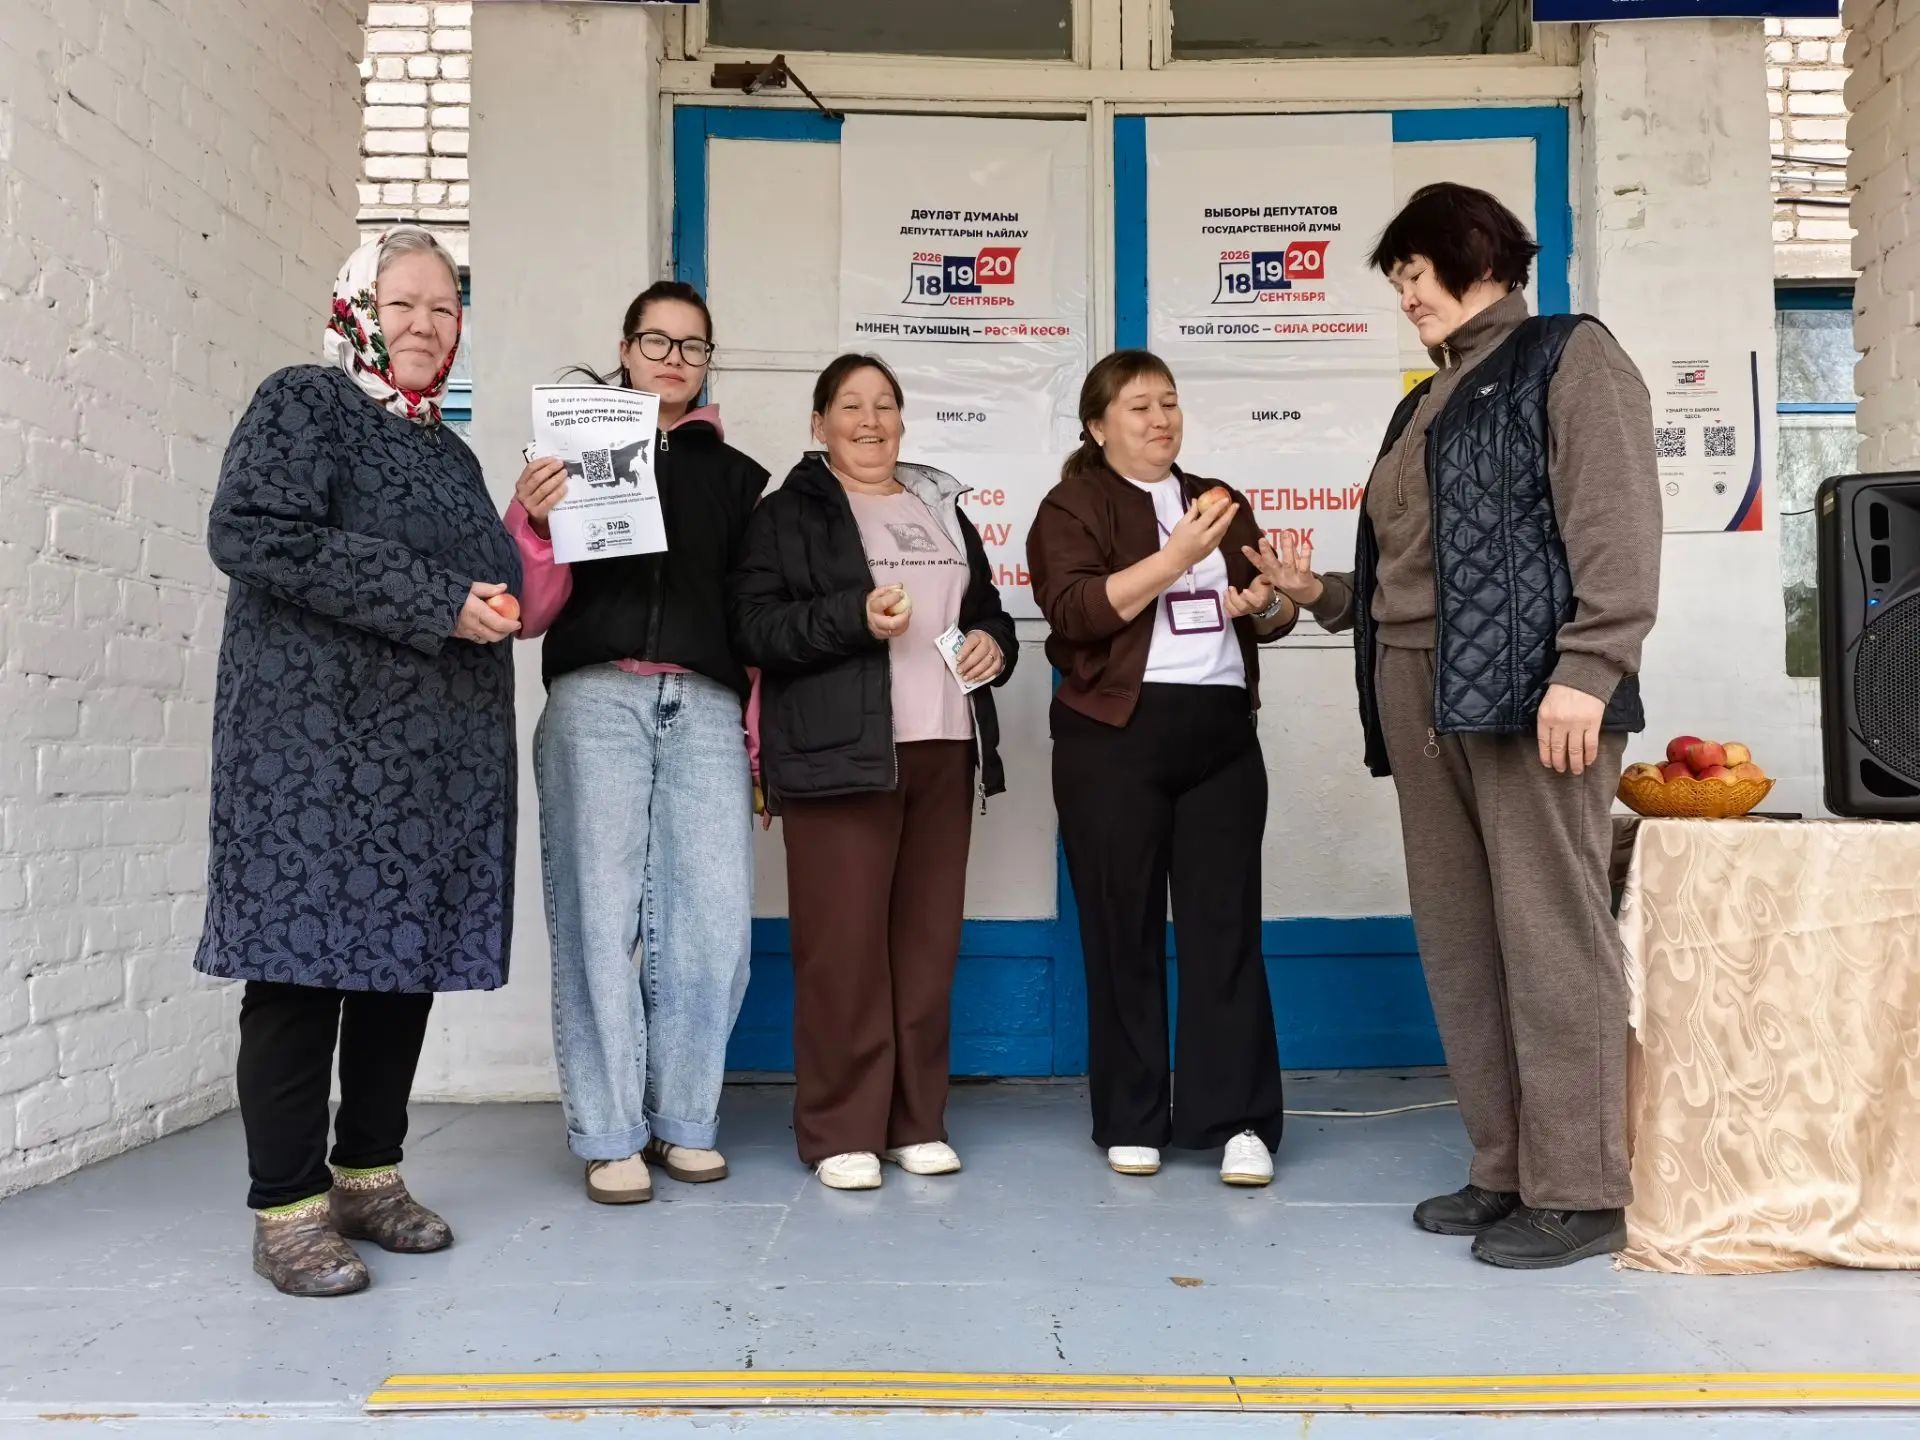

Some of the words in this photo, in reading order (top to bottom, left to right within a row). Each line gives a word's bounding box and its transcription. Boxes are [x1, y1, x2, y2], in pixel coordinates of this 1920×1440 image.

[1204, 207, 1260, 217] ВЫБОРЫ
[1263, 205, 1338, 217] ДЕПУТАТОВ
[900, 226, 983, 237] ДЕПУТАТТАРЫН
[1201, 221, 1306, 234] ГОСУДАРСТВЕННОЙ
[1308, 223, 1341, 233] ДУМЫ
[912, 252, 942, 262] 2026
[1220, 250, 1250, 260] 2026
[916, 275, 942, 295] 18
[947, 265, 974, 286] 19
[979, 256, 1012, 276] 20
[1224, 273, 1251, 294] 18
[1255, 261, 1283, 282] 19
[1288, 250, 1321, 271] 20
[949, 296, 1015, 306] СЕНТЯБРЬ
[1259, 291, 1326, 302] СЕНТЯБРЯ
[1179, 322, 1214, 335] ТВОЙ
[1217, 323, 1260, 335] ГОЛОС
[1274, 323, 1309, 334] СИЛА
[1311, 322, 1368, 333] РОССИИ!
[1695, 371, 1704, 379] 20
[575, 408, 608, 416] участие
[936, 411, 986, 423] ЦИК.РФ
[1252, 411, 1302, 422] ЦИК.РФ
[578, 416, 590, 424] СО
[606, 520, 630, 530] БУДЬ
[974, 523, 1012, 546] АУ
[1260, 528, 1314, 550] ТОК
[901, 558, 926, 566] leaves
